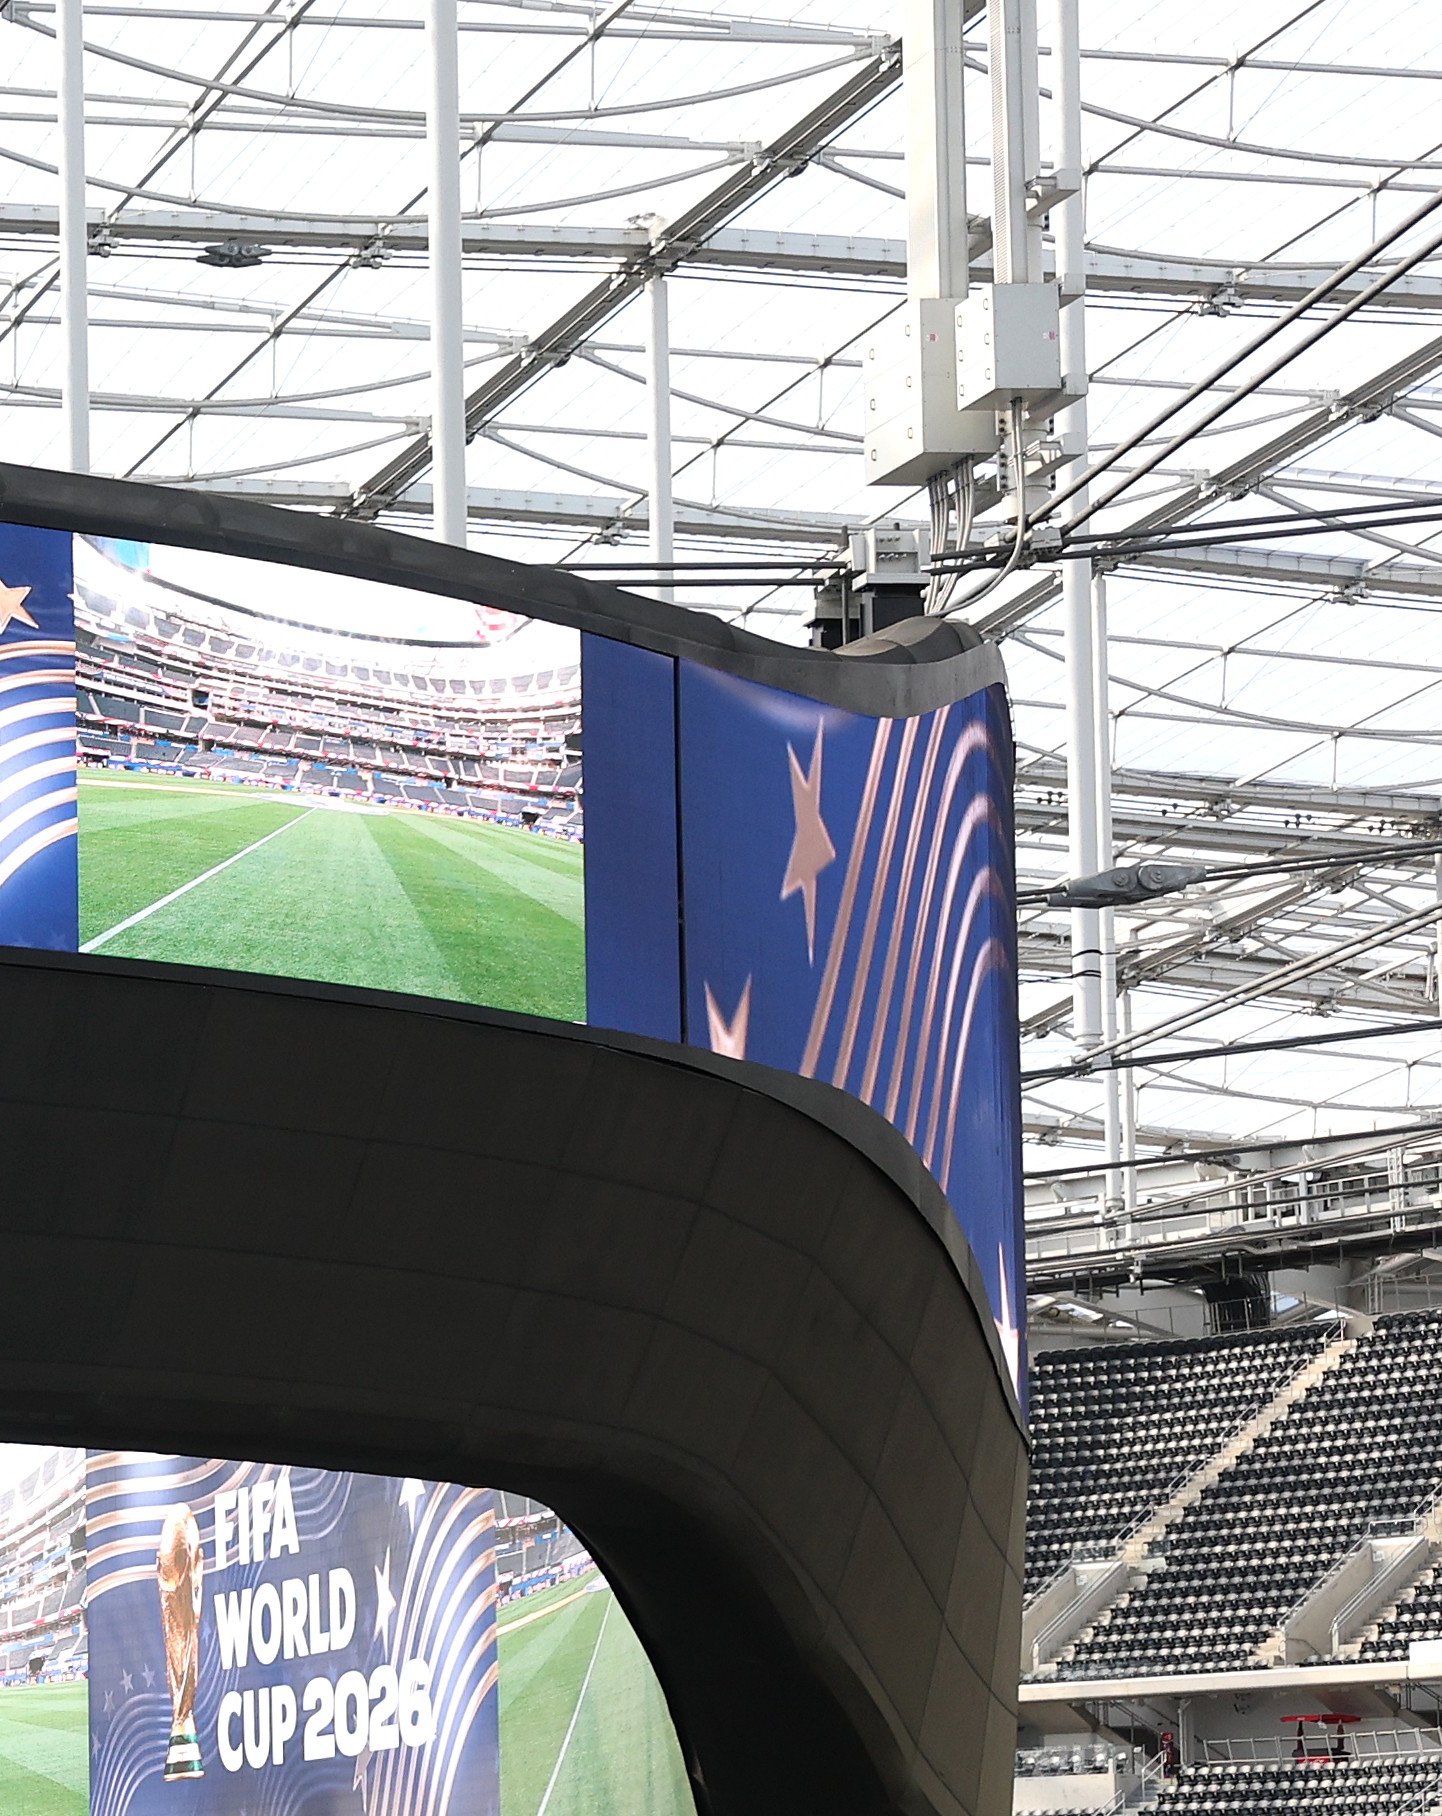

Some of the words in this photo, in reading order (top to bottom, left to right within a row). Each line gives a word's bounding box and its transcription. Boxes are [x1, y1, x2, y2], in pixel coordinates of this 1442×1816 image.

[215, 1474, 300, 1568] FIFA
[213, 1571, 357, 1671] WORLD
[217, 1683, 297, 1772] CUP
[302, 1657, 435, 1763] 2026
